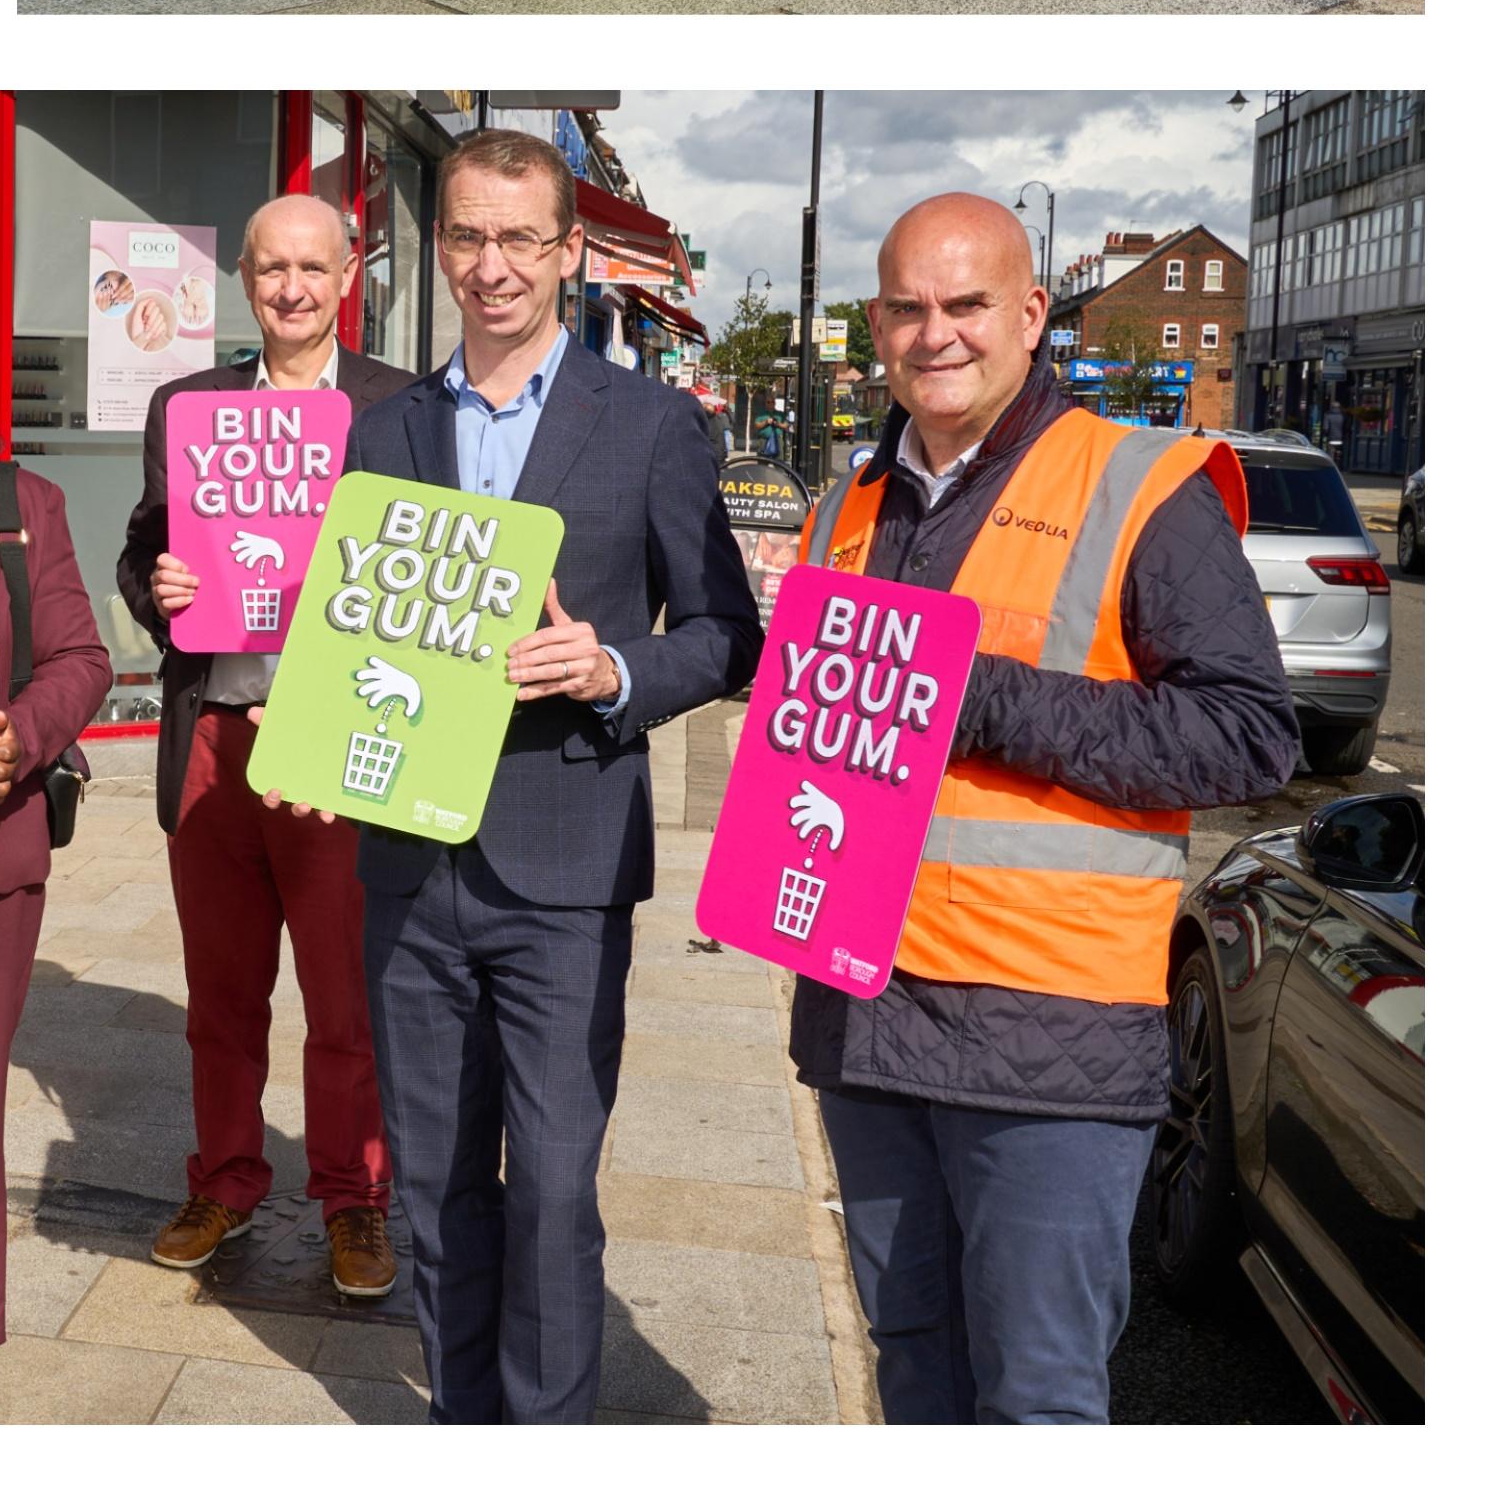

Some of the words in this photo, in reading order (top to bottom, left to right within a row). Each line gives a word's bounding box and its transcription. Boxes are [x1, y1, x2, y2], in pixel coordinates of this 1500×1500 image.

[132, 242, 176, 254] COCO
[213, 406, 302, 443] BIN
[184, 443, 332, 480] YOUR
[192, 480, 325, 518] GUM.
[719, 481, 793, 498] AKSPA
[723, 497, 754, 507] AUTY
[758, 499, 798, 511] SALON
[380, 500, 499, 562] BIN
[727, 508, 750, 518] ITH
[754, 509, 781, 520] SPA
[1016, 516, 1068, 540] VEOLIA
[338, 536, 521, 618] YOUR
[325, 585, 493, 663] GUM.
[816, 595, 922, 668] BIN
[781, 641, 940, 733] YOUR
[768, 698, 909, 785] GUM.
